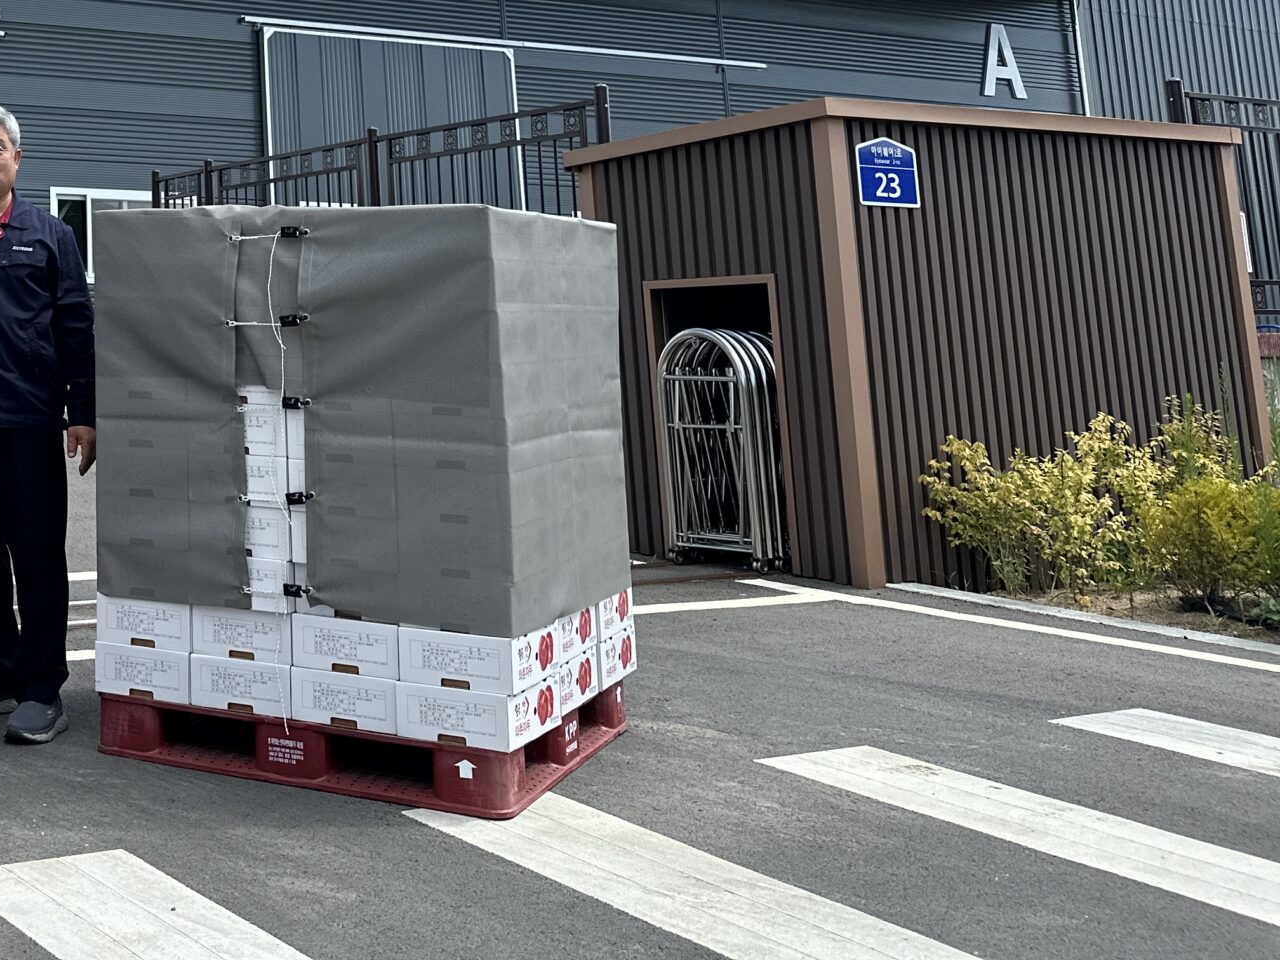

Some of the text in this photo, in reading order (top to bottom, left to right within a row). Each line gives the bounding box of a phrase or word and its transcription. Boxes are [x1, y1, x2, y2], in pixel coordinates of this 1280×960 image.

[981, 23, 1028, 100] A
[874, 172, 901, 198] 23
[564, 720, 577, 742] KPP
